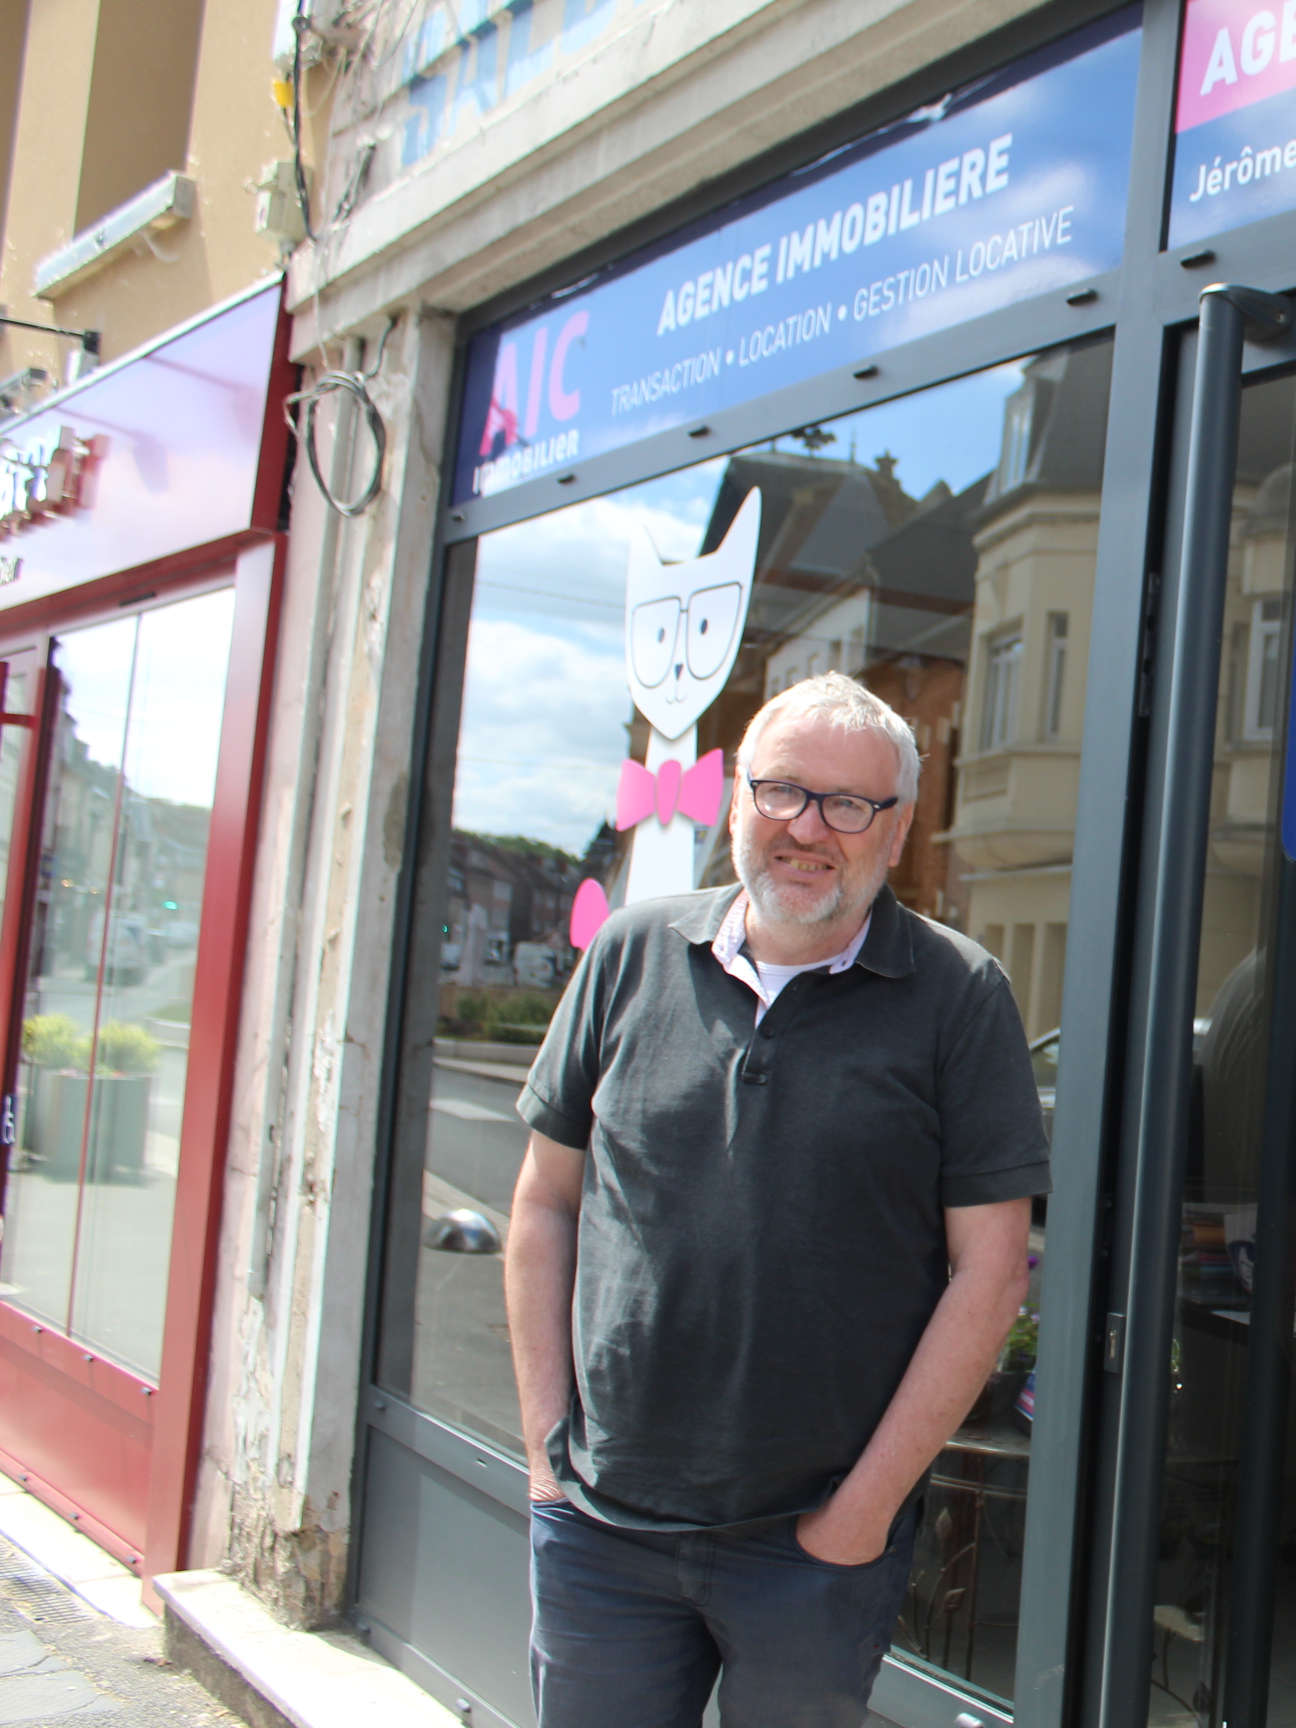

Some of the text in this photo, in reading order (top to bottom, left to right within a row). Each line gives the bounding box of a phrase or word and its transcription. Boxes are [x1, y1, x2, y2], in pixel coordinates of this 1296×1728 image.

[611, 204, 1075, 418] TRANSACTION LOCATION GESTION LOCATIVE
[656, 132, 1013, 338] AGENCE IMMOBILIERE
[479, 310, 590, 458] AIC
